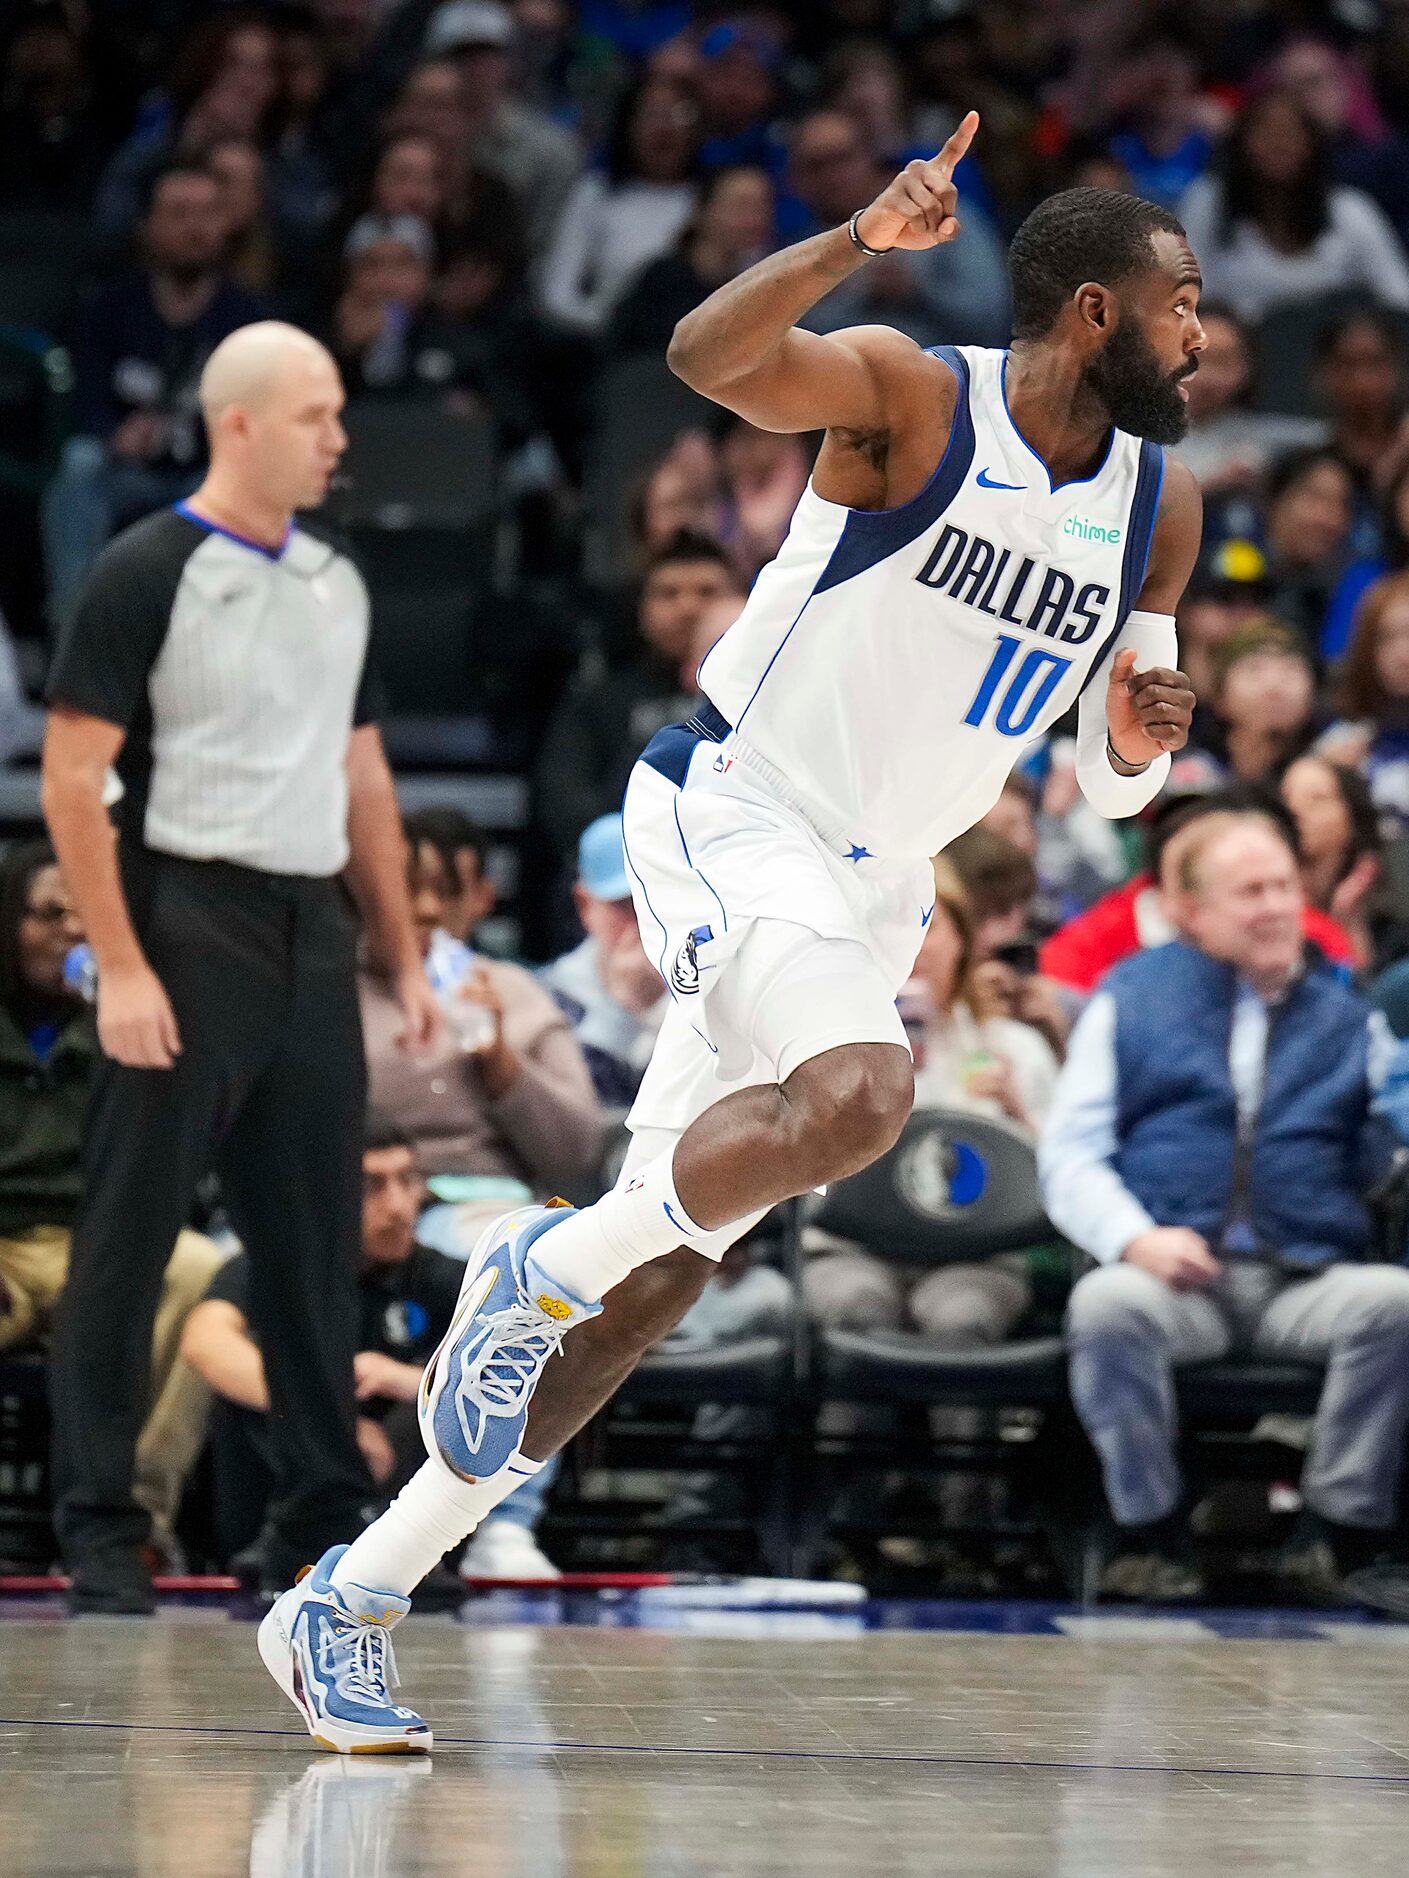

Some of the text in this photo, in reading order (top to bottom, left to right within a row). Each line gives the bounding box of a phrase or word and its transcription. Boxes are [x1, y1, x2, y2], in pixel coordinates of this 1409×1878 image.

[1063, 514, 1121, 544] chime
[914, 522, 1111, 645] DALLAS
[961, 632, 1076, 738] 10
